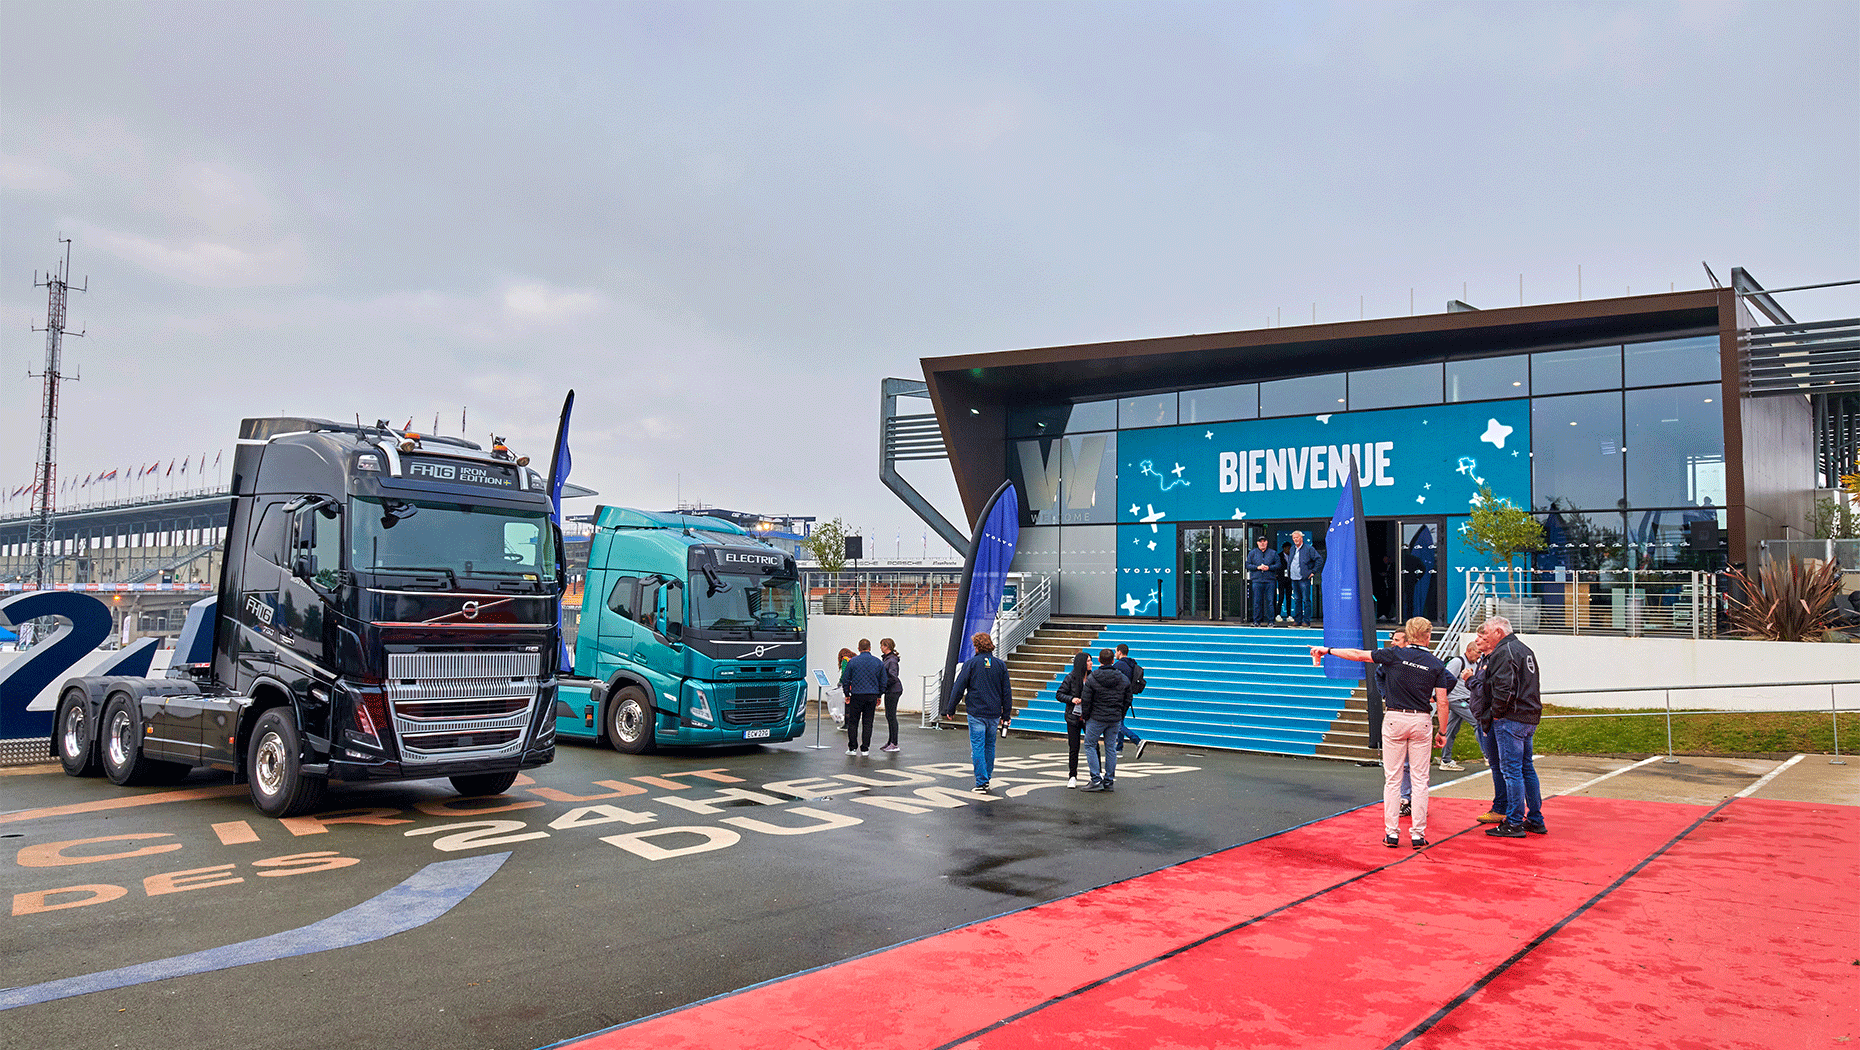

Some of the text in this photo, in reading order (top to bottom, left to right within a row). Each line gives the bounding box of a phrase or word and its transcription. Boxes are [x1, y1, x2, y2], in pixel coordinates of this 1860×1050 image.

[410, 462, 456, 480] FH16
[460, 467, 487, 477] IRON
[1219, 441, 1395, 493] BIENVENUE
[460, 474, 502, 485] EDITION
[1030, 512, 1091, 523] WELOME
[984, 532, 1013, 547] VOLVO
[725, 553, 778, 565] ELECTRIC
[245, 595, 275, 625] FH16
[1402, 660, 1430, 671] ELECTRIC
[598, 806, 865, 861] DU
[11, 851, 361, 917] DES
[403, 804, 658, 852] 24
